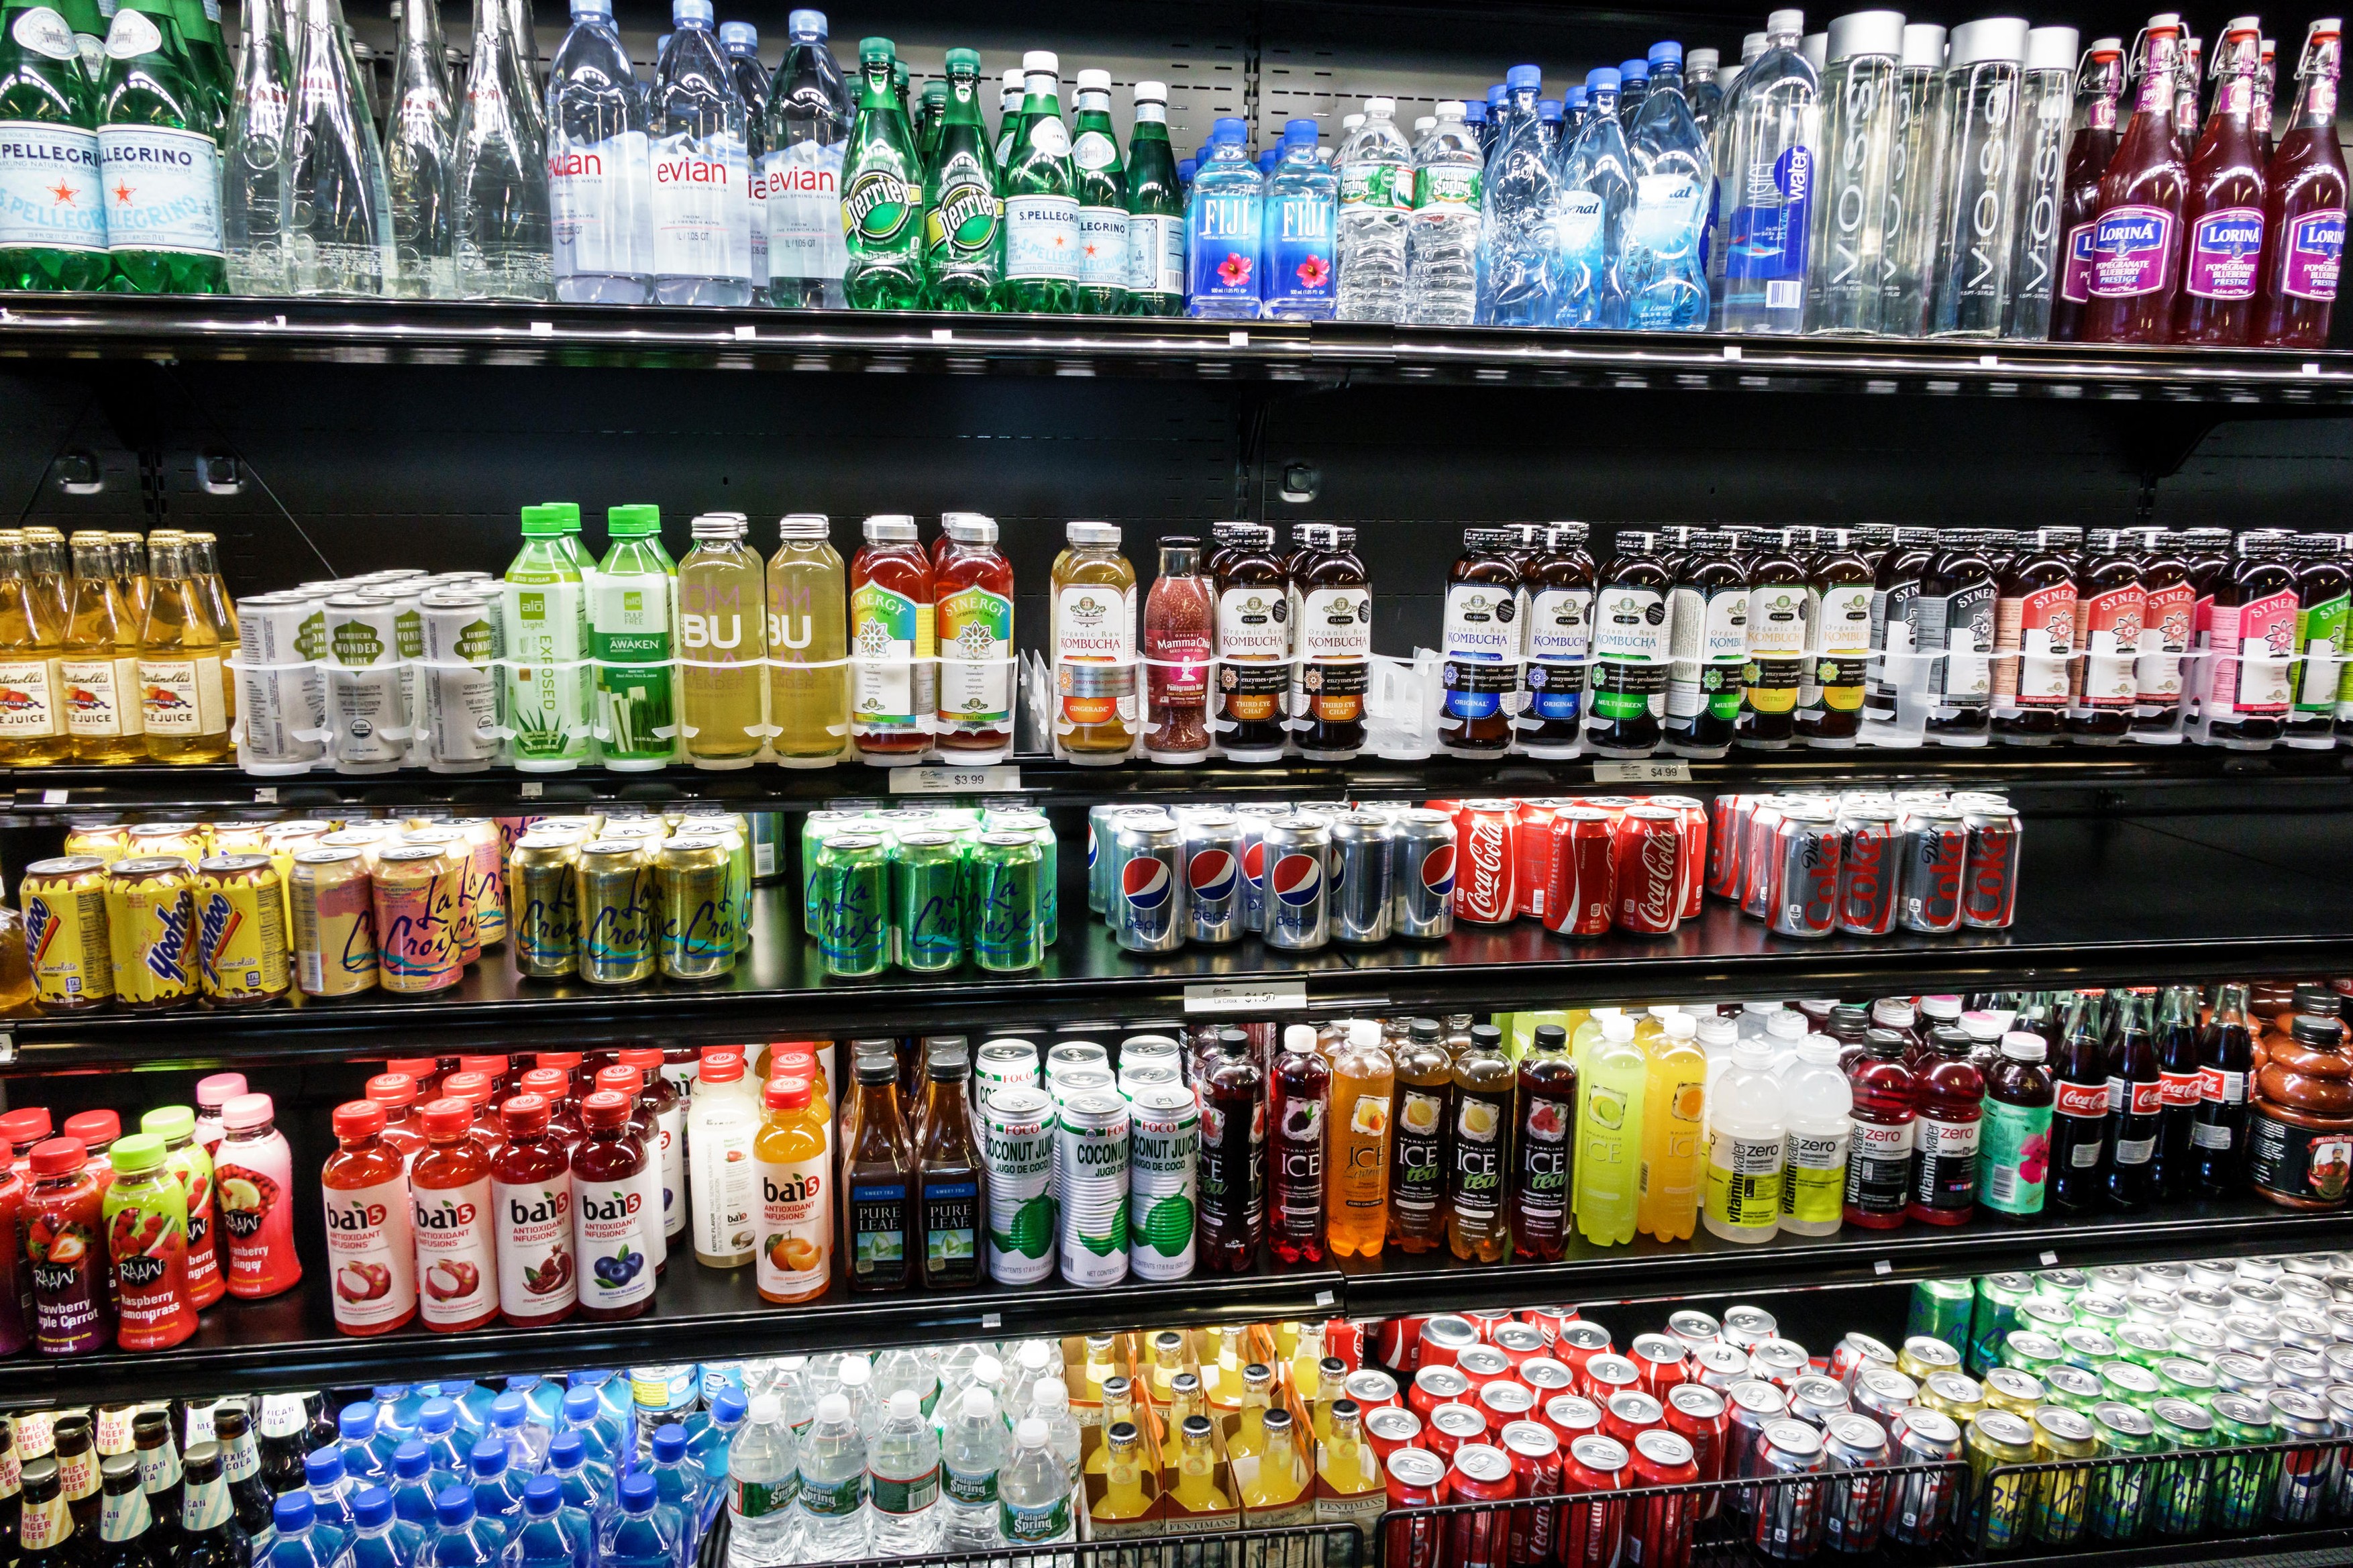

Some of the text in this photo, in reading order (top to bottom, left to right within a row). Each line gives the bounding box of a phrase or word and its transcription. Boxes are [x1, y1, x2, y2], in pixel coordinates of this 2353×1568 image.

[658, 157, 727, 184] evian
[1439, 171, 1469, 183] Poland
[1786, 150, 1808, 203] water
[770, 166, 834, 193] evian
[1832, 80, 1873, 284] VOSS
[1968, 82, 2010, 289] VOSS
[1433, 180, 1472, 197] Spring
[1205, 200, 1249, 236] FIJI
[1282, 201, 1327, 237] FIJI
[687, 232, 698, 240] 1.05
[2099, 223, 2154, 242] LORINA
[2209, 227, 2259, 243] LORINA
[2096, 260, 2149, 270] POMEGRANATE
[2099, 268, 2140, 276] BLUEBERRY
[2205, 264, 2255, 272] POMEGRANATE
[2213, 270, 2250, 278] BLUEBERRY
[853, 595, 908, 617] SYNERGY
[945, 596, 1006, 617] SYNERGY
[956, 610, 976, 619] organic
[522, 621, 545, 630] Light
[684, 615, 741, 648] BU
[1223, 627, 1261, 636] Organic
[1449, 625, 1483, 633] Organic
[338, 632, 371, 641] KOMBUCHA
[1061, 629, 1120, 639] Organic Raw
[1308, 629, 1347, 637] Organic
[1448, 632, 1508, 645] KOMBUCHA
[611, 640, 660, 649] AWAKEN
[1061, 638, 1120, 649] KOMBUCHA
[1157, 637, 1211, 650] Mamma Chia
[1223, 635, 1283, 647] KOMBUCHA
[1308, 636, 1367, 648] KOMBUCHA
[1597, 636, 1656, 647] KOMBUCHA
[336, 643, 378, 654] WONDER
[344, 657, 368, 665] DRINK
[1455, 699, 1487, 707] ORIGINAL
[1598, 699, 1642, 708] MULTI-GREEN
[79, 714, 111, 723] JUICE
[158, 713, 193, 722] JUICE
[1651, 768, 1677, 777] $4.99
[955, 775, 984, 785] $3.99
[1467, 820, 1503, 918] Coca-Cola
[1638, 823, 1675, 928] Coca-Cola
[1965, 826, 2007, 921] Coke
[1801, 831, 1838, 930] Diet Coke
[1840, 829, 1883, 926] Coke
[1922, 827, 1963, 926] Diet Coke
[834, 866, 869, 915] La
[417, 874, 452, 930] La
[1192, 908, 1233, 923] pepsi
[1275, 914, 1317, 929] pepsi
[384, 916, 461, 969] Croix
[38, 961, 78, 972] Chocolate
[1005, 1124, 1039, 1135] FOCO
[1143, 1121, 1176, 1133] FOCO
[1865, 1129, 1900, 1142] zero
[986, 1142, 1033, 1161] COCONUT
[1746, 1144, 1778, 1157] zero
[996, 1159, 1048, 1173] JUGO DE COCO
[1153, 1160, 1186, 1171] DE COCO
[1282, 1153, 1320, 1178] ICE
[1457, 1149, 1496, 1175] ICE
[1847, 1122, 1865, 1202] vitaminwater
[1464, 1171, 1500, 1189] tea
[1727, 1141, 1746, 1223] vitaminwater
[764, 1201, 815, 1212] ANTIOXIDANT
[859, 1207, 901, 1219] PURE
[225, 1212, 260, 1231] RAAW
[513, 1218, 565, 1234] ANTIOXIDANT
[585, 1218, 637, 1231] ANTIOXIDANT
[859, 1219, 895, 1231] LEAF
[330, 1230, 380, 1241] ANTIOXIDANT
[513, 1229, 557, 1243] INFUSIONS
[585, 1229, 627, 1238] INFUSIONS
[119, 1261, 162, 1281] RAAW
[232, 1259, 262, 1273] Ginger
[35, 1267, 74, 1288] RAAW
[121, 1290, 174, 1308] Raspberry
[60, 1308, 99, 1327] Carrot
[17, 1418, 47, 1434] SPICY
[16, 1425, 52, 1444] GINGER
[23, 1435, 50, 1451] BEER
[225, 1457, 252, 1471] COLA
[805, 1481, 833, 1495] Poland
[802, 1488, 837, 1508] Spring
[1319, 1498, 1384, 1510] FENTIMANS
[1017, 1511, 1049, 1523] Poland
[1014, 1517, 1051, 1532] Spring
[1169, 1518, 1237, 1531] FENTIMANS
